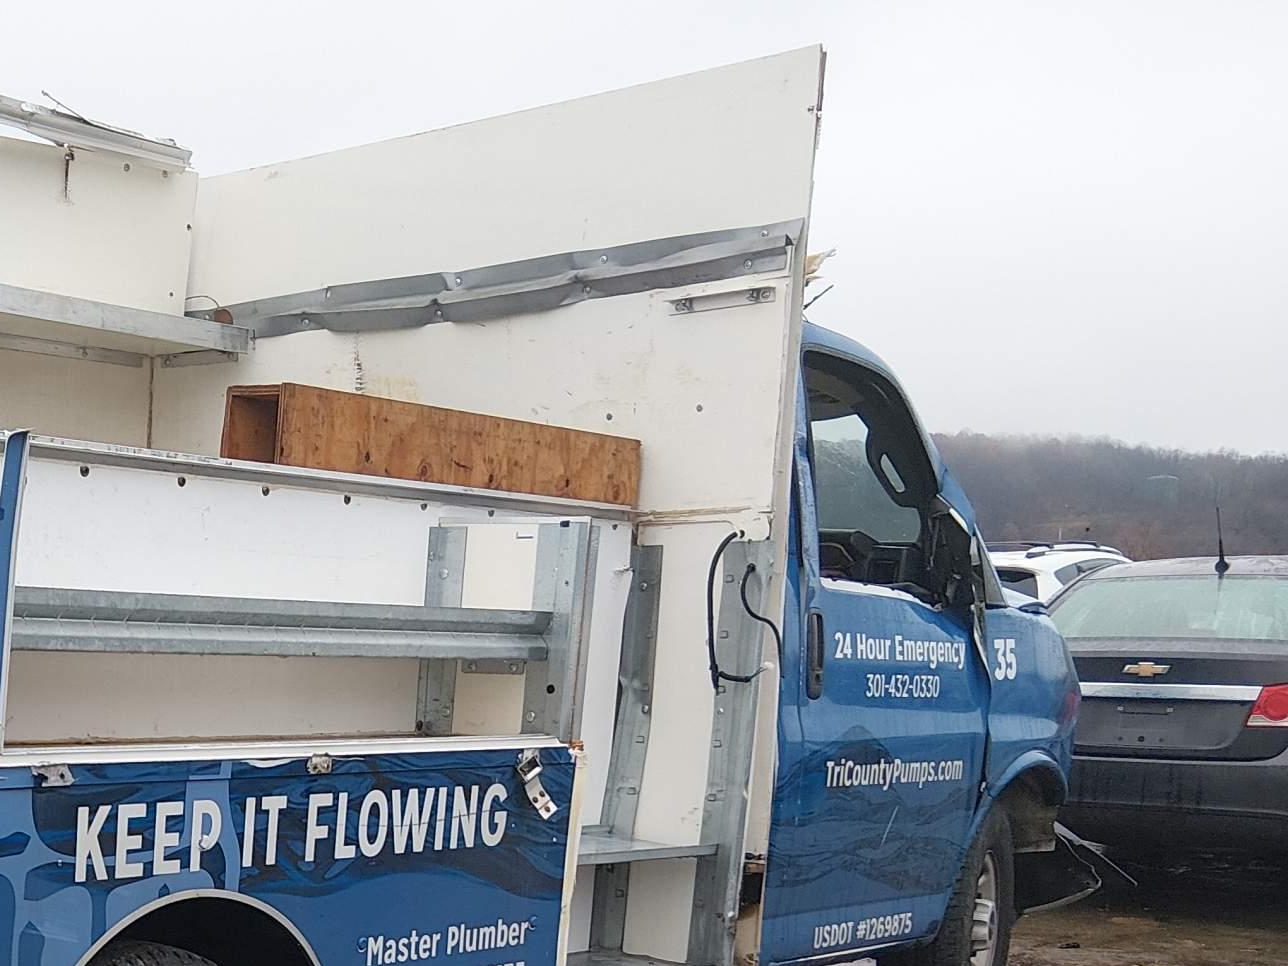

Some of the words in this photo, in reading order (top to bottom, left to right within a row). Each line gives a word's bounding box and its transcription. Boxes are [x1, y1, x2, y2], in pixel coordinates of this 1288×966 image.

[834, 632, 853, 659] 24
[856, 633, 892, 661] Hour
[894, 635, 966, 669] Emergency
[993, 638, 1017, 681] 35
[865, 673, 941, 699] 301-432-0330
[825, 757, 964, 792] TriCountyPumps.com
[74, 799, 222, 883] KEEP
[241, 795, 289, 868] IT
[304, 783, 509, 863] FLOWING
[366, 929, 442, 966] Master
[446, 918, 529, 955] Plumber
[813, 921, 855, 949] USDOT
[855, 912, 913, 941] #1269875
